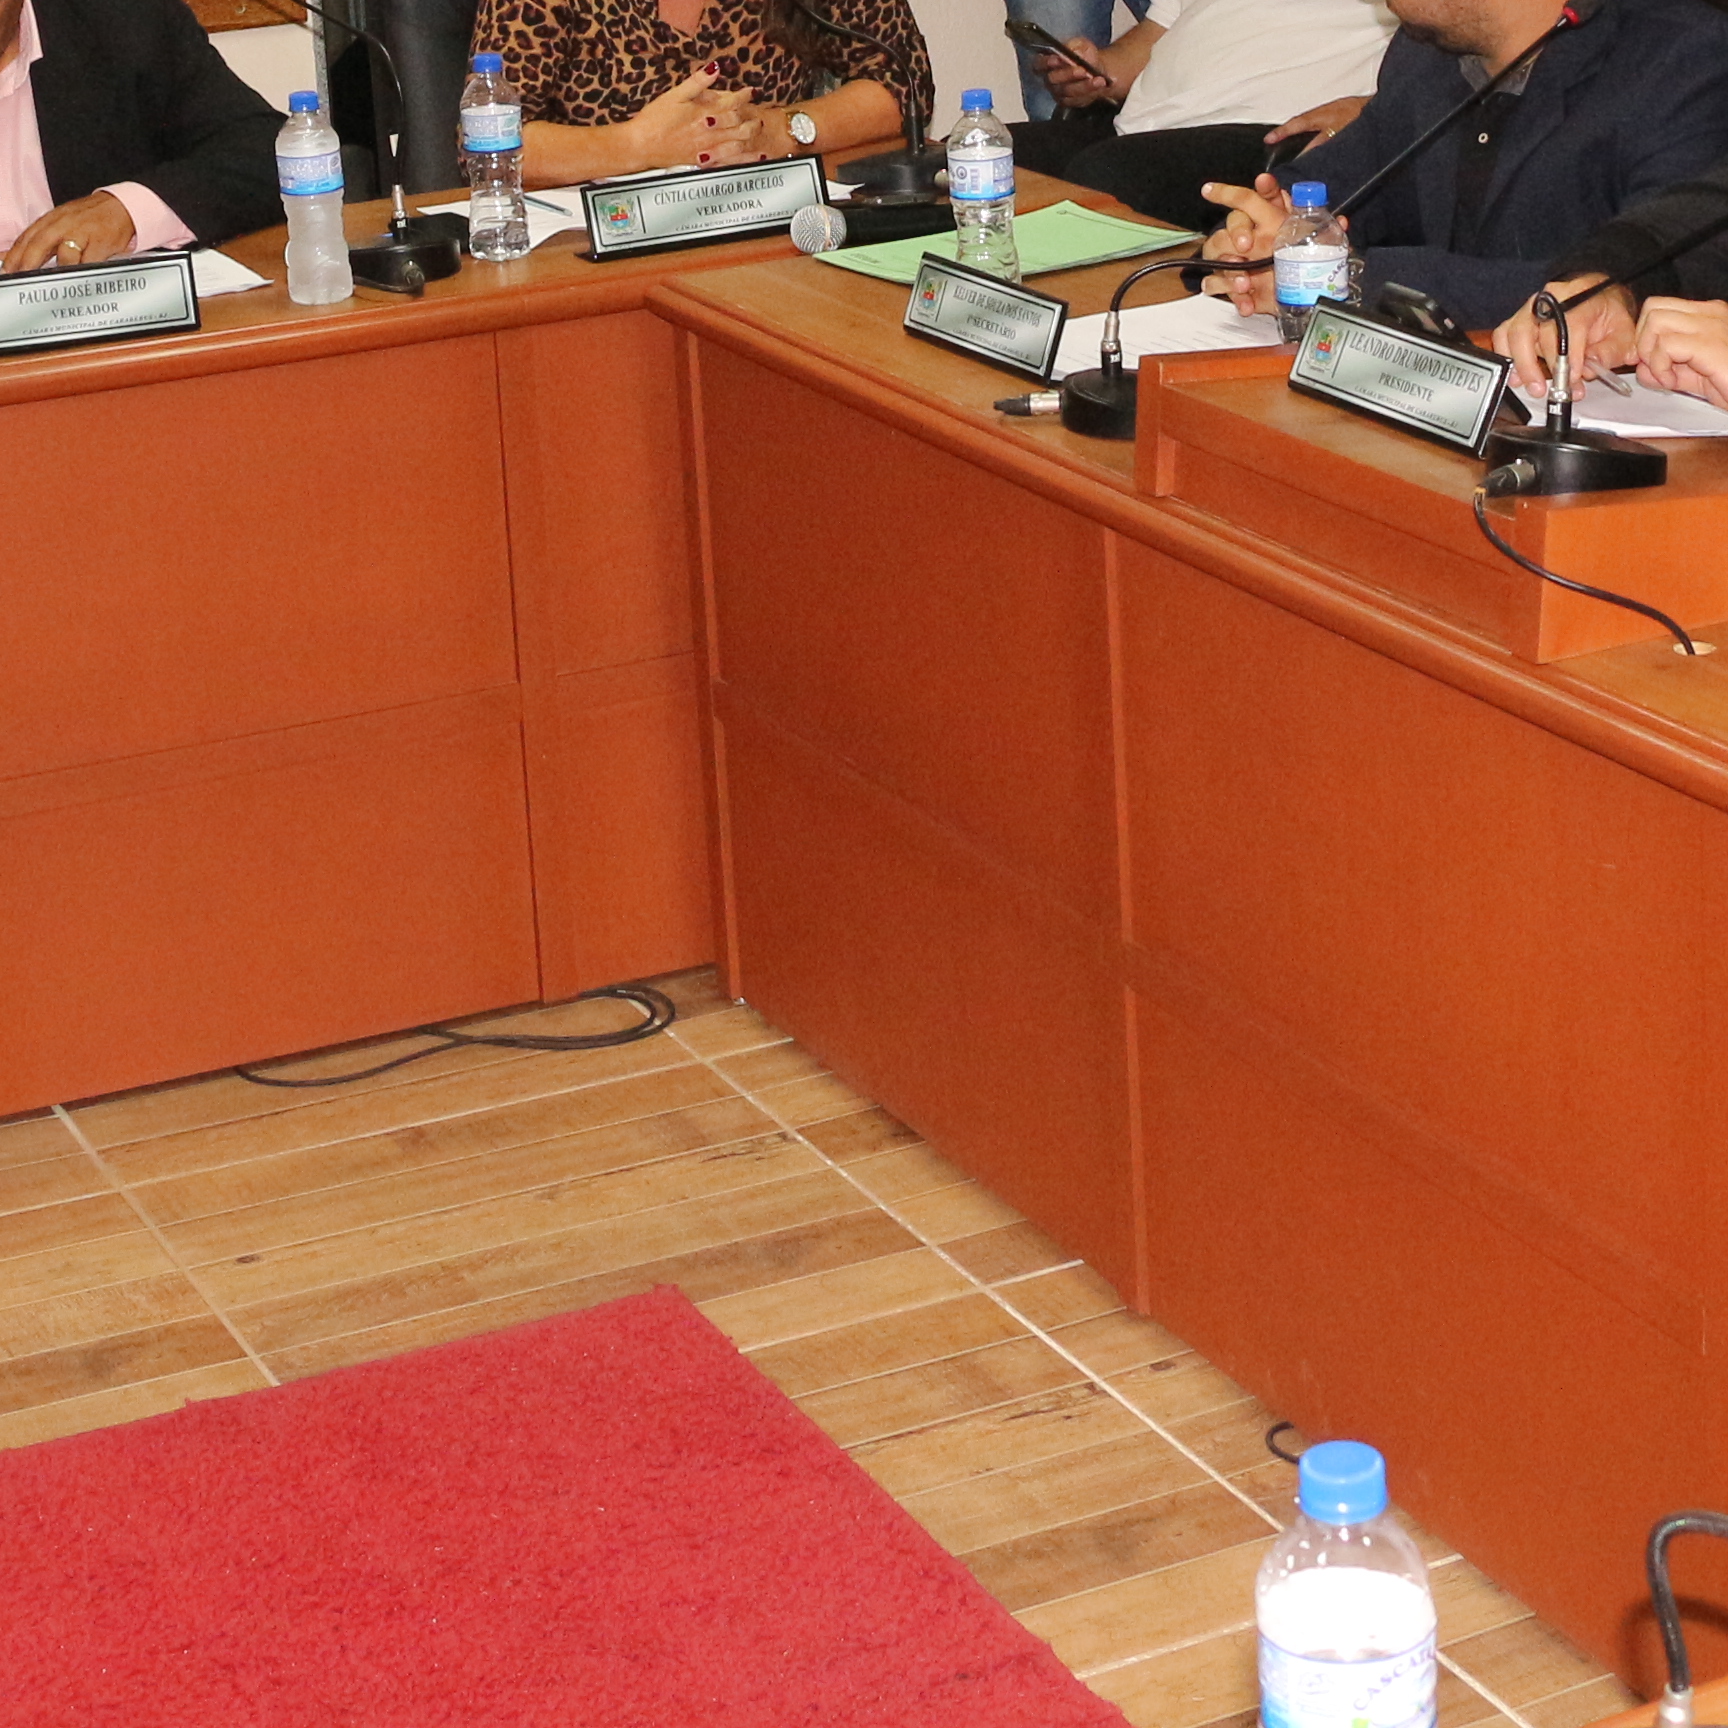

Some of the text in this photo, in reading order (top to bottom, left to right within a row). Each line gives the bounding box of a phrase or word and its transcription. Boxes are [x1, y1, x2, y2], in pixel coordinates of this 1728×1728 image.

[688, 182, 735, 201] CAMARGO
[736, 174, 784, 193] BARCELOS
[695, 198, 764, 217] VEREADORA
[18, 277, 147, 305] PAULO JOSÉ RIBEIRO
[51, 302, 120, 319] VEREADOR
[1349, 331, 1485, 394] LEANDRO DRUMOND ESTEVES
[1378, 372, 1435, 403] PRESIDENTE
